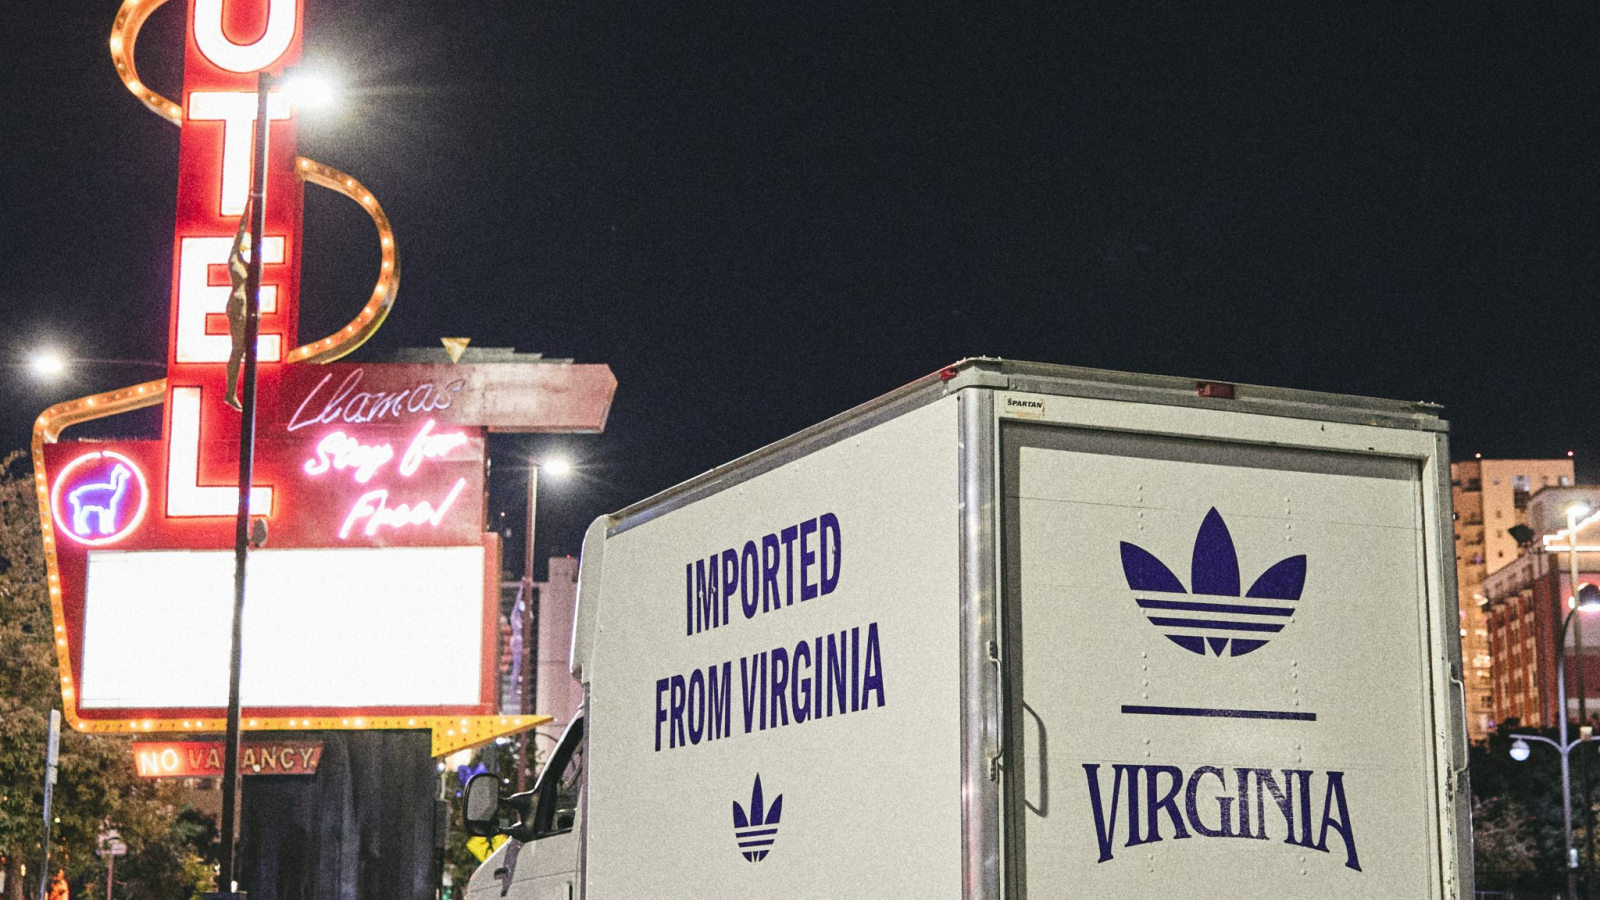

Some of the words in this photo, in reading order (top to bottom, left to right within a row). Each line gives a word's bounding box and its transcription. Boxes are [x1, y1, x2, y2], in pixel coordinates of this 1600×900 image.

[1007, 398, 1043, 408] SPARTAN
[304, 431, 394, 483] Stay
[399, 419, 467, 476] for
[686, 512, 841, 636] IMPORTED
[655, 662, 731, 752] FROM
[740, 622, 885, 734] VIRGINIA
[140, 748, 179, 774] NO
[188, 746, 313, 771] VAANCY
[1082, 764, 1362, 872] VIRGINIA
